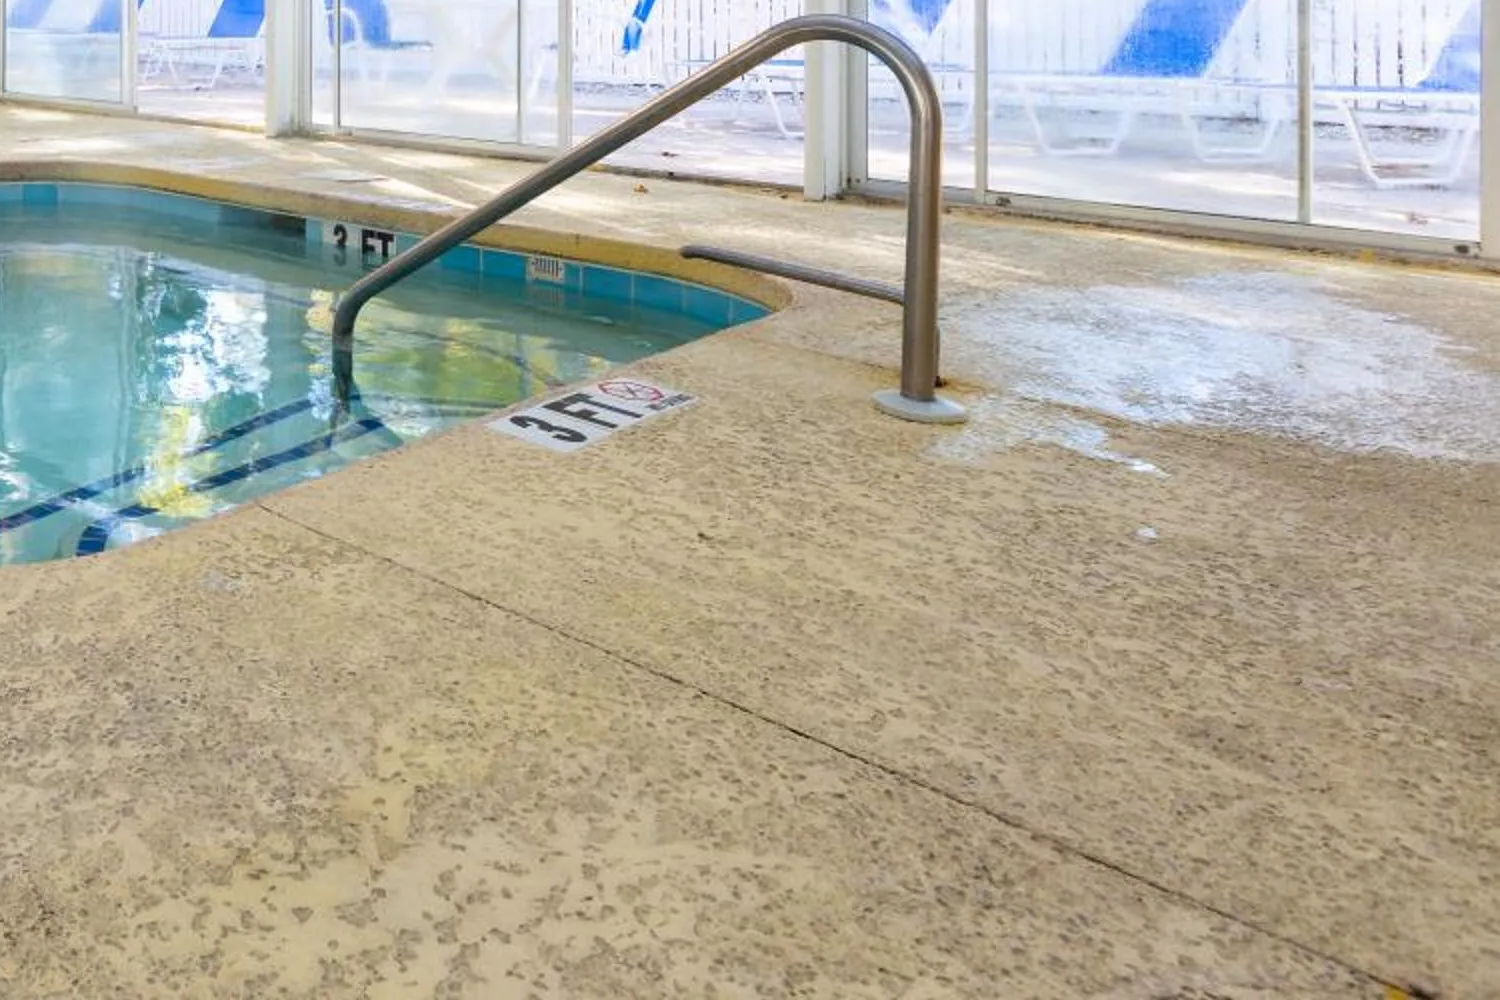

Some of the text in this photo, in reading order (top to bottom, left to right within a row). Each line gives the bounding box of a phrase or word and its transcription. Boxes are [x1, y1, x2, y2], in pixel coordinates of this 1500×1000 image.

[361, 228, 395, 259] FT
[540, 391, 645, 429] FT
[508, 414, 589, 443] 3
